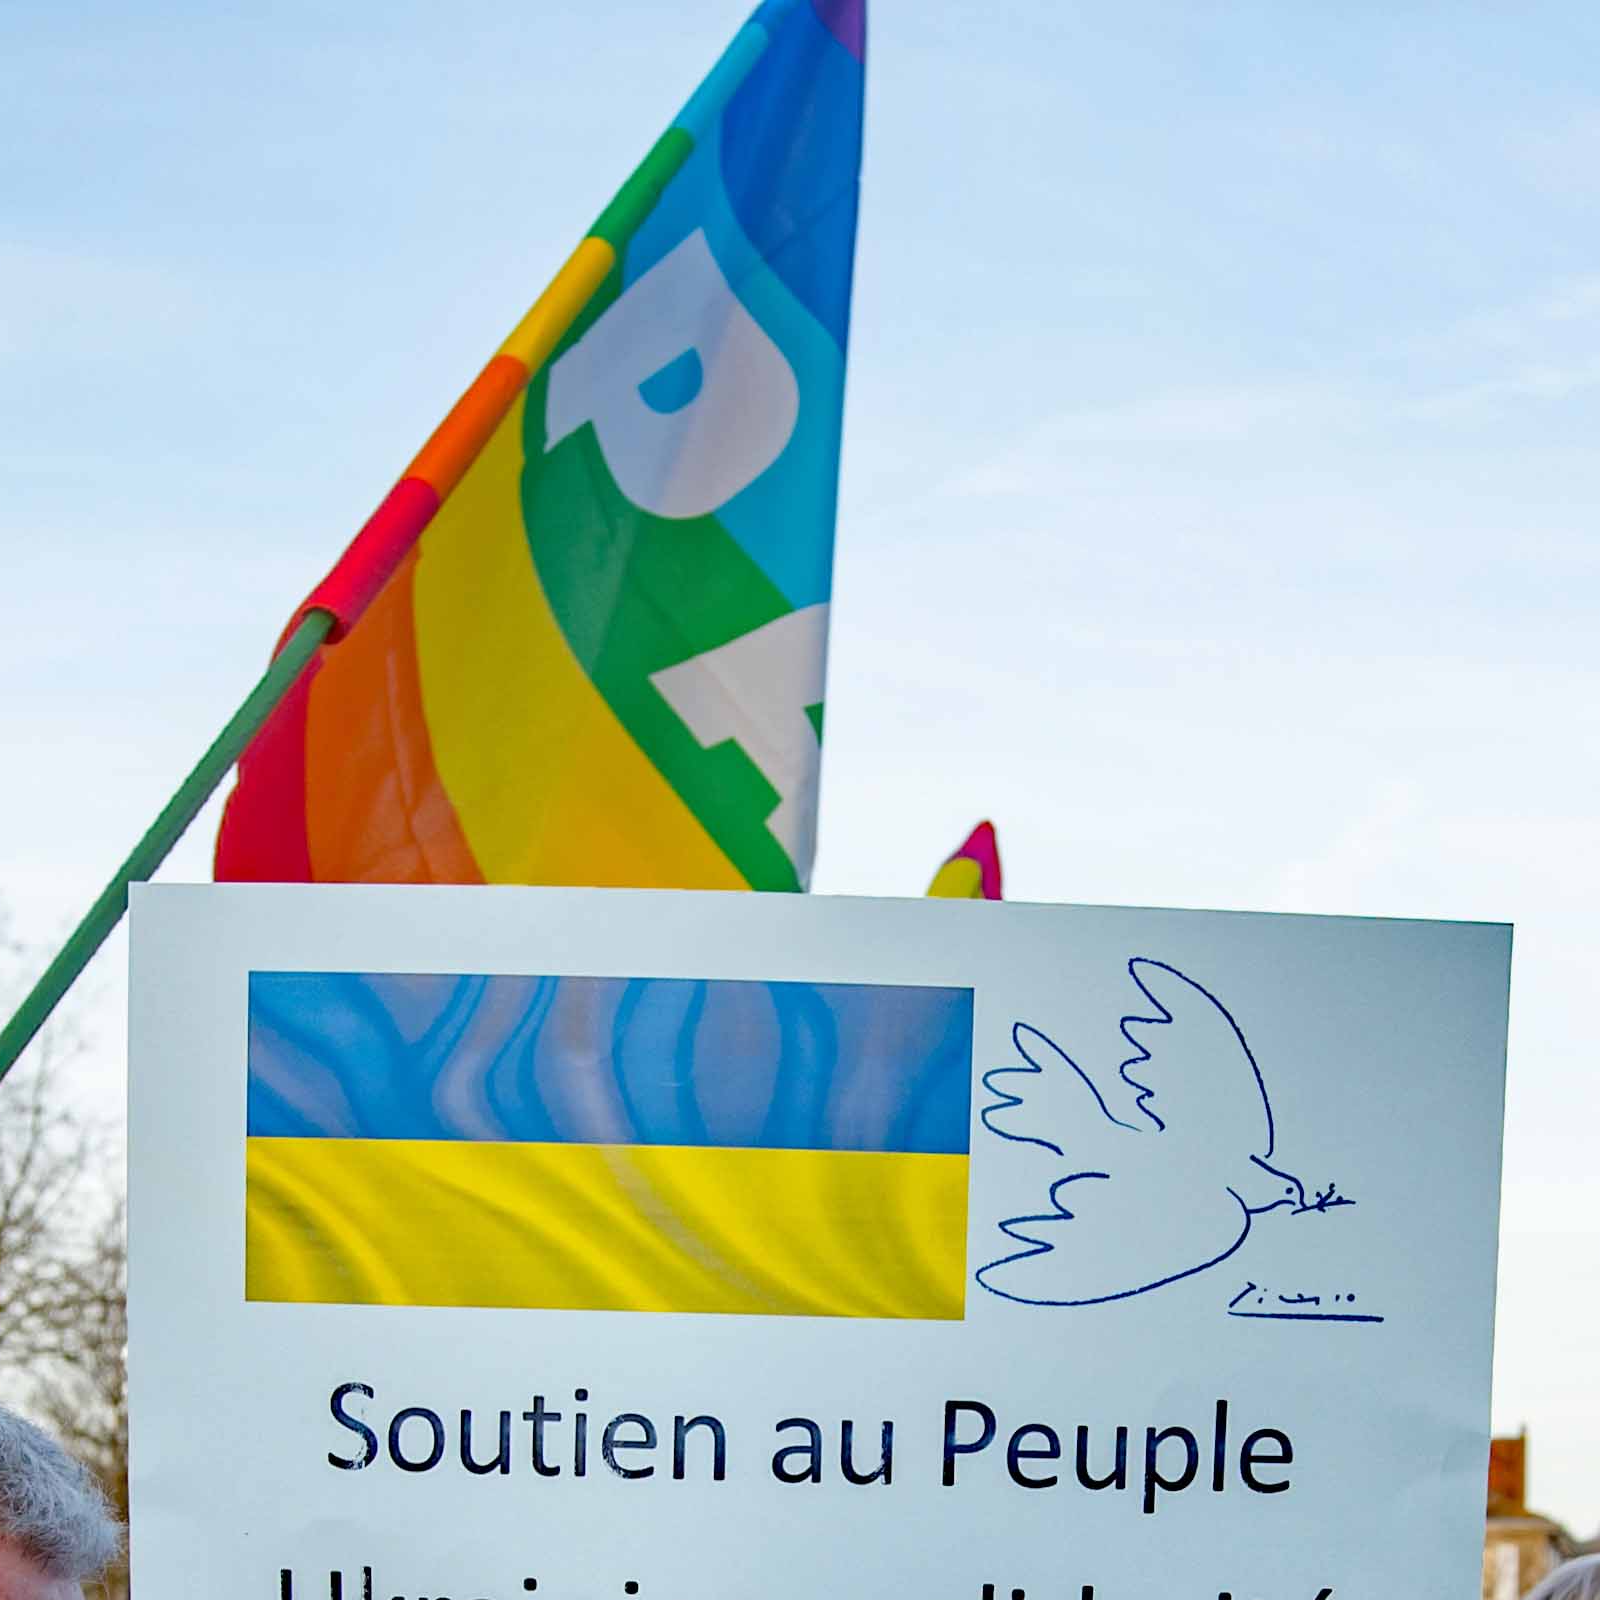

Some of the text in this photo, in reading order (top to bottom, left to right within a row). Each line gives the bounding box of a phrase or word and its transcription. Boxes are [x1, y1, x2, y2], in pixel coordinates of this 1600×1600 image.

[327, 1382, 1294, 1515] Soutien au Peuple
